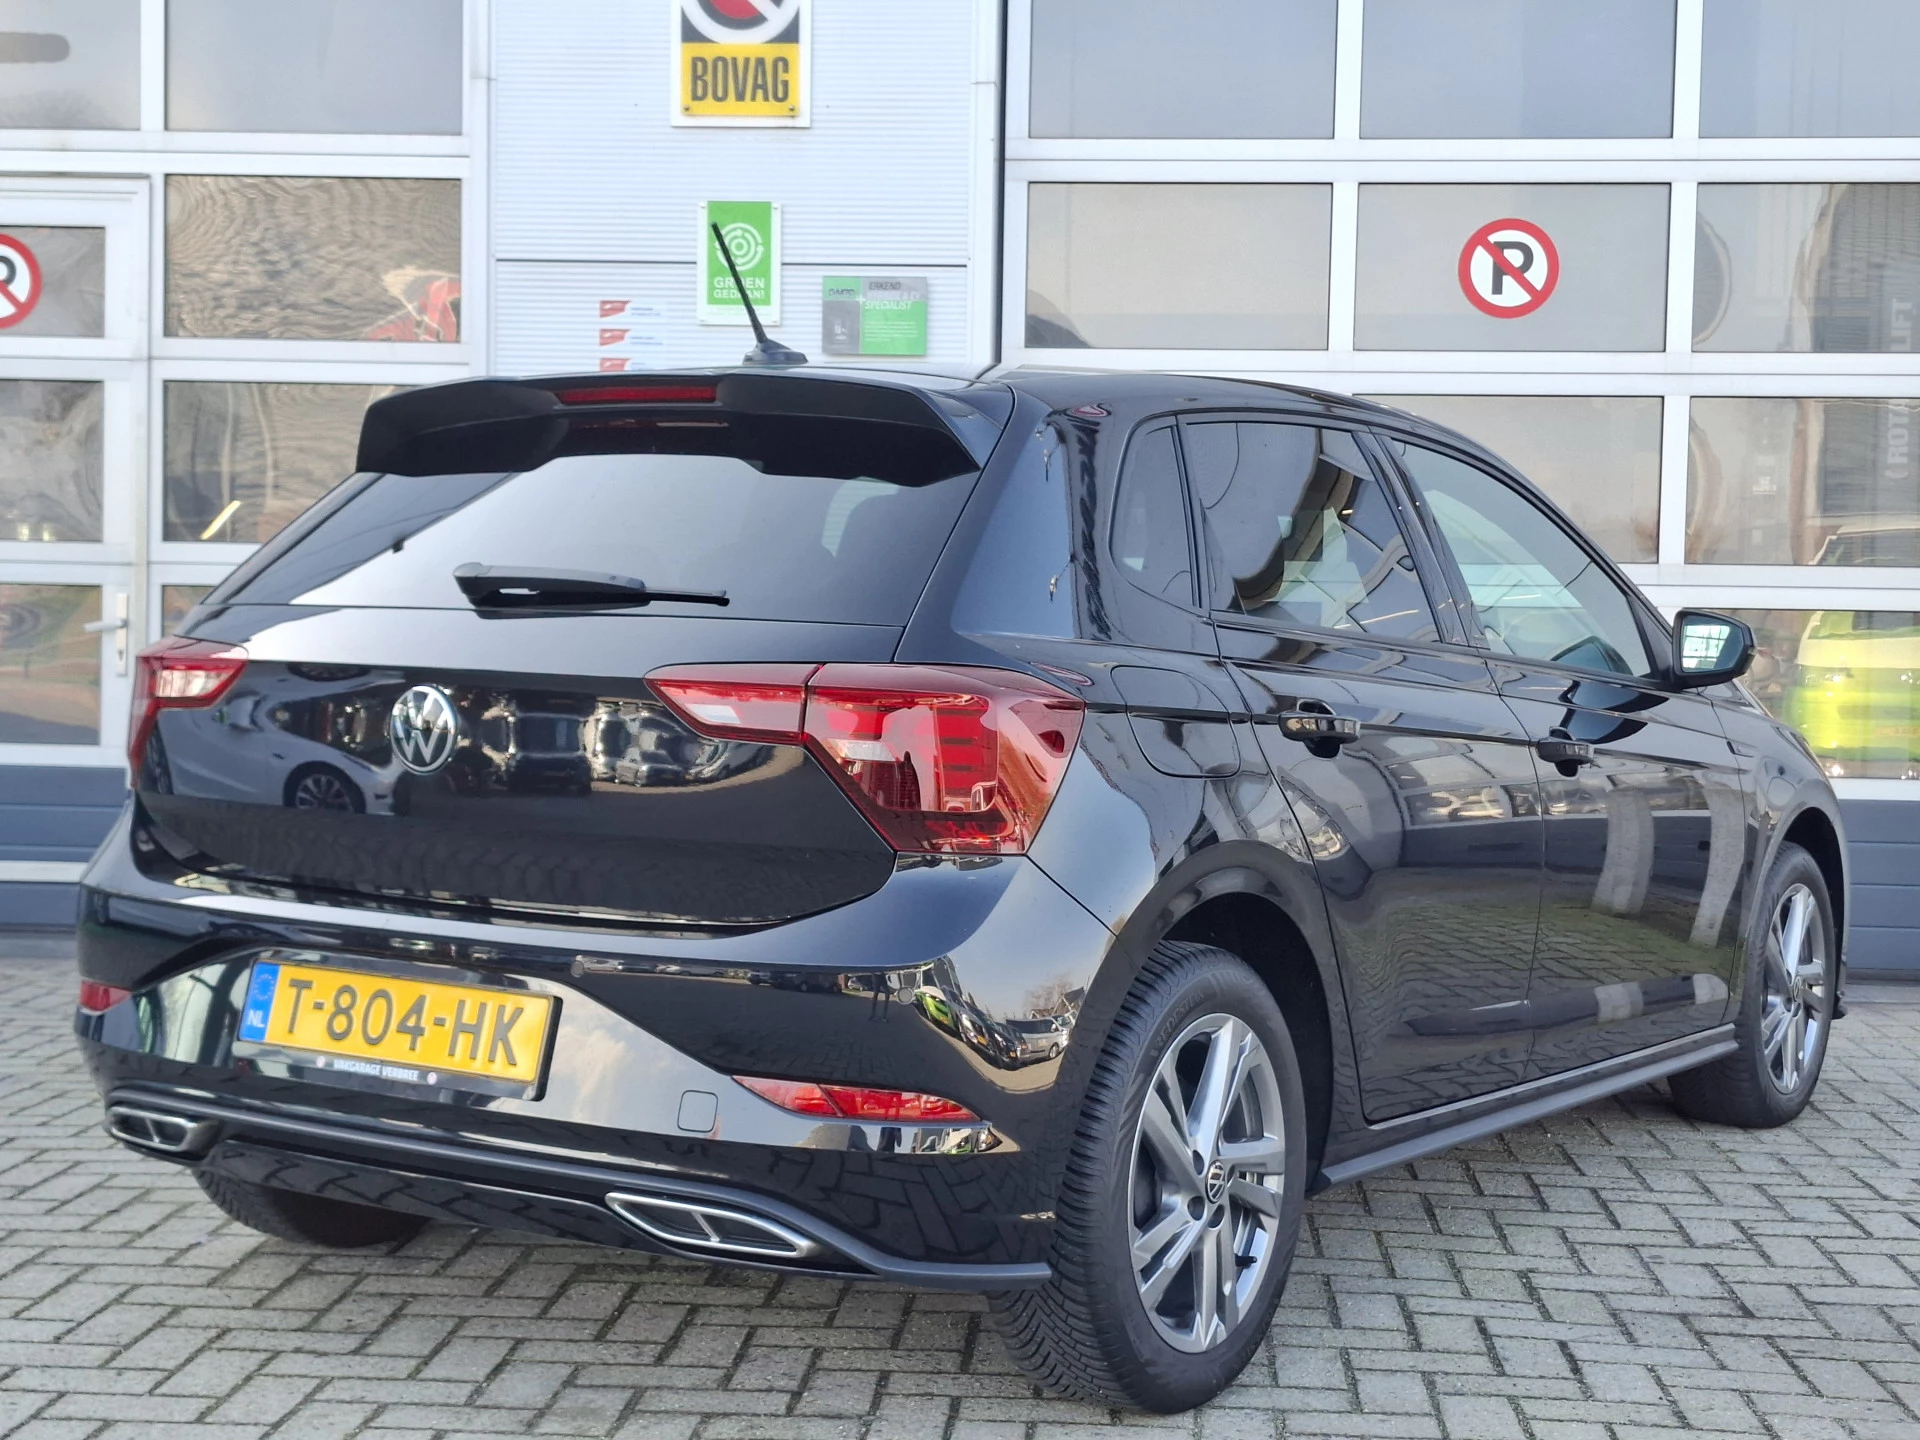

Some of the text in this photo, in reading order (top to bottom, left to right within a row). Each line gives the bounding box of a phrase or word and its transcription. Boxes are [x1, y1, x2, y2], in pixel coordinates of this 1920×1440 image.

[690, 56, 789, 103] BOVAG
[1491, 240, 1534, 295] P
[864, 300, 913, 310] SPECIALIST
[247, 1009, 265, 1028] NL
[287, 977, 524, 1066] T-804-HK
